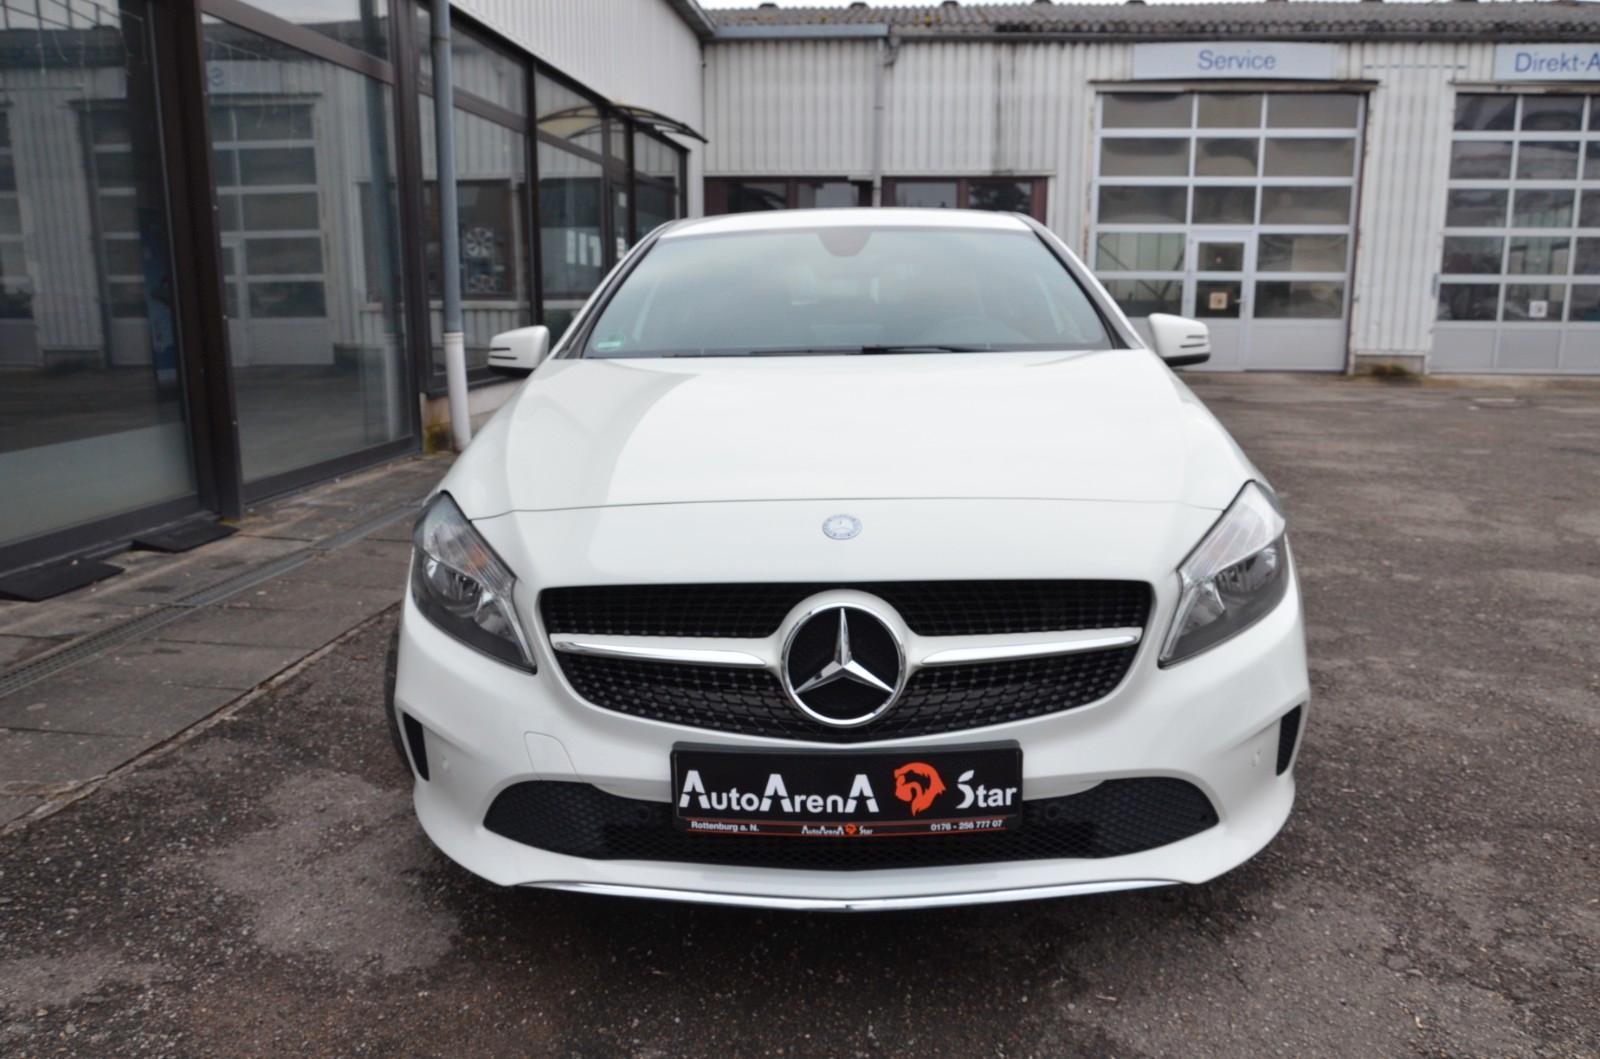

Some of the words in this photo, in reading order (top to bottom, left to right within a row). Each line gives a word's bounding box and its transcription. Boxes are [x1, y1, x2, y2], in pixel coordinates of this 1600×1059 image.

[1198, 49, 1276, 70] Service
[1514, 51, 1600, 72] Direkt-A
[679, 769, 880, 813] AutoArenA
[956, 769, 1017, 809] Star
[691, 820, 738, 832] Rottenburg
[976, 820, 990, 828] 777
[991, 819, 1003, 827] 07
